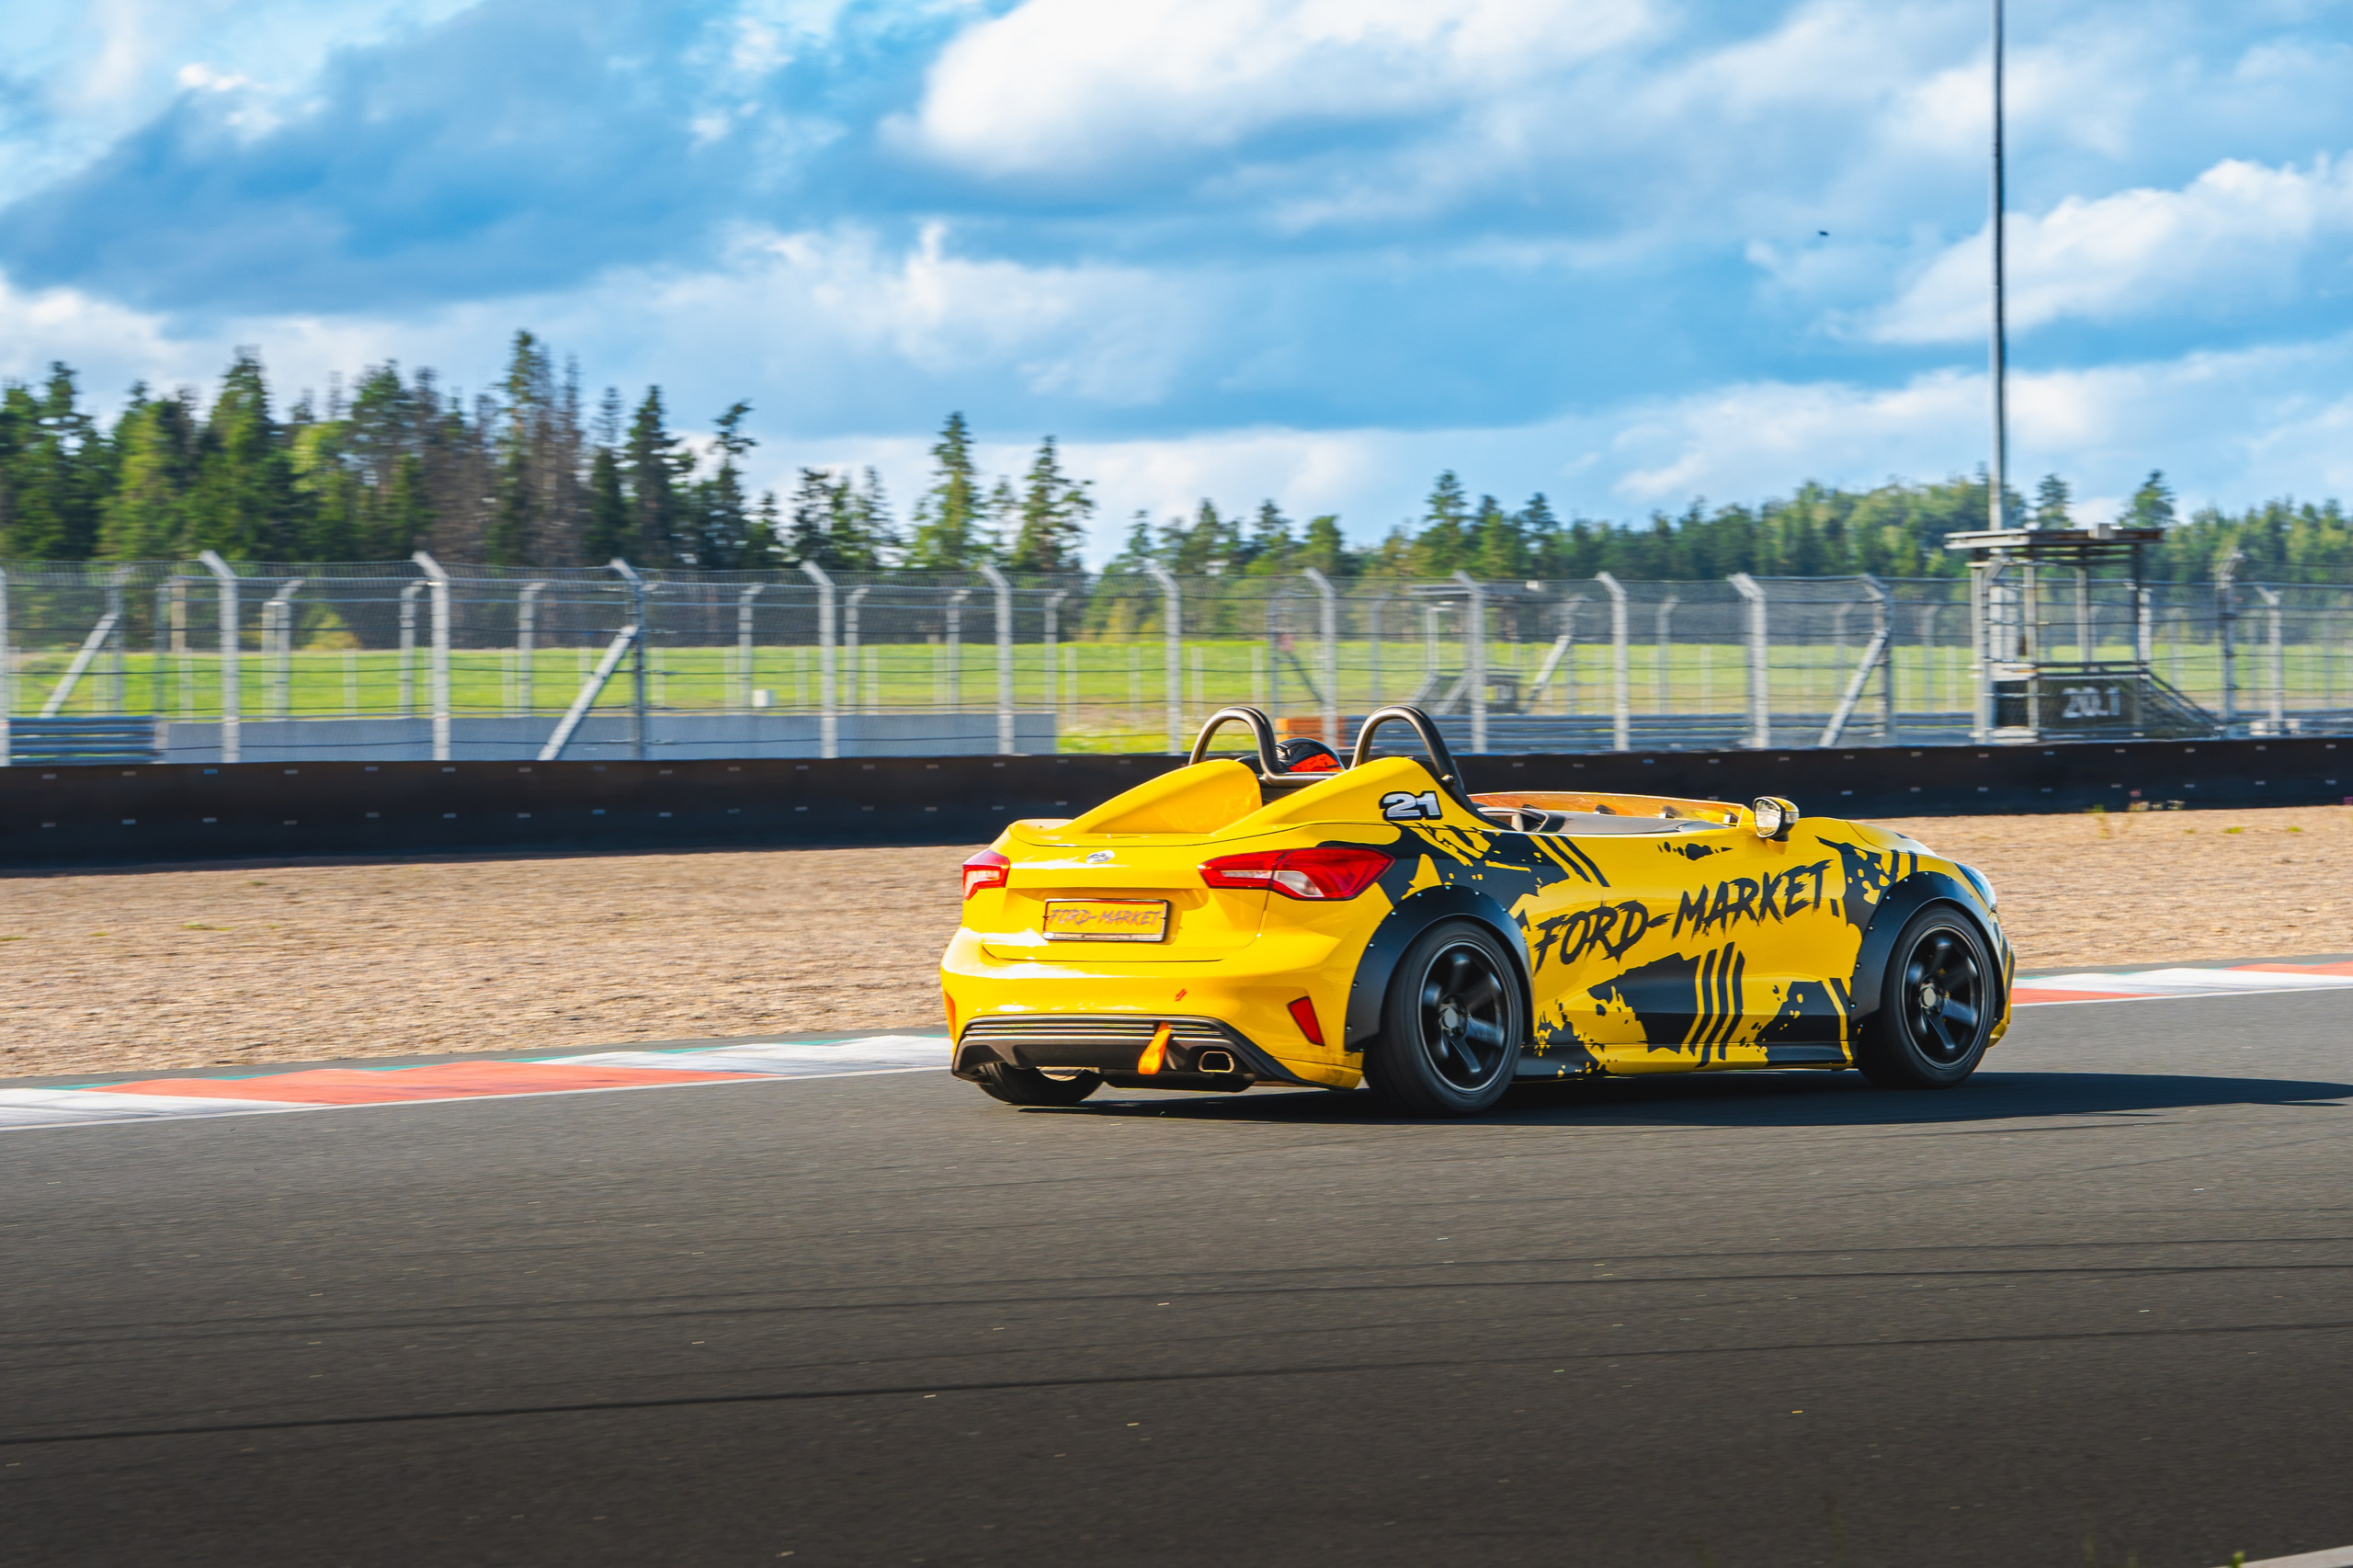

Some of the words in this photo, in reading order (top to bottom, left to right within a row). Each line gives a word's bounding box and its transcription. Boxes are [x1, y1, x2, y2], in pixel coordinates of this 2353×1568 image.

[1381, 791, 1442, 820] 21
[1049, 908, 1163, 926] FORD-MARKET
[1533, 859, 1834, 975] FORD-MARKET
